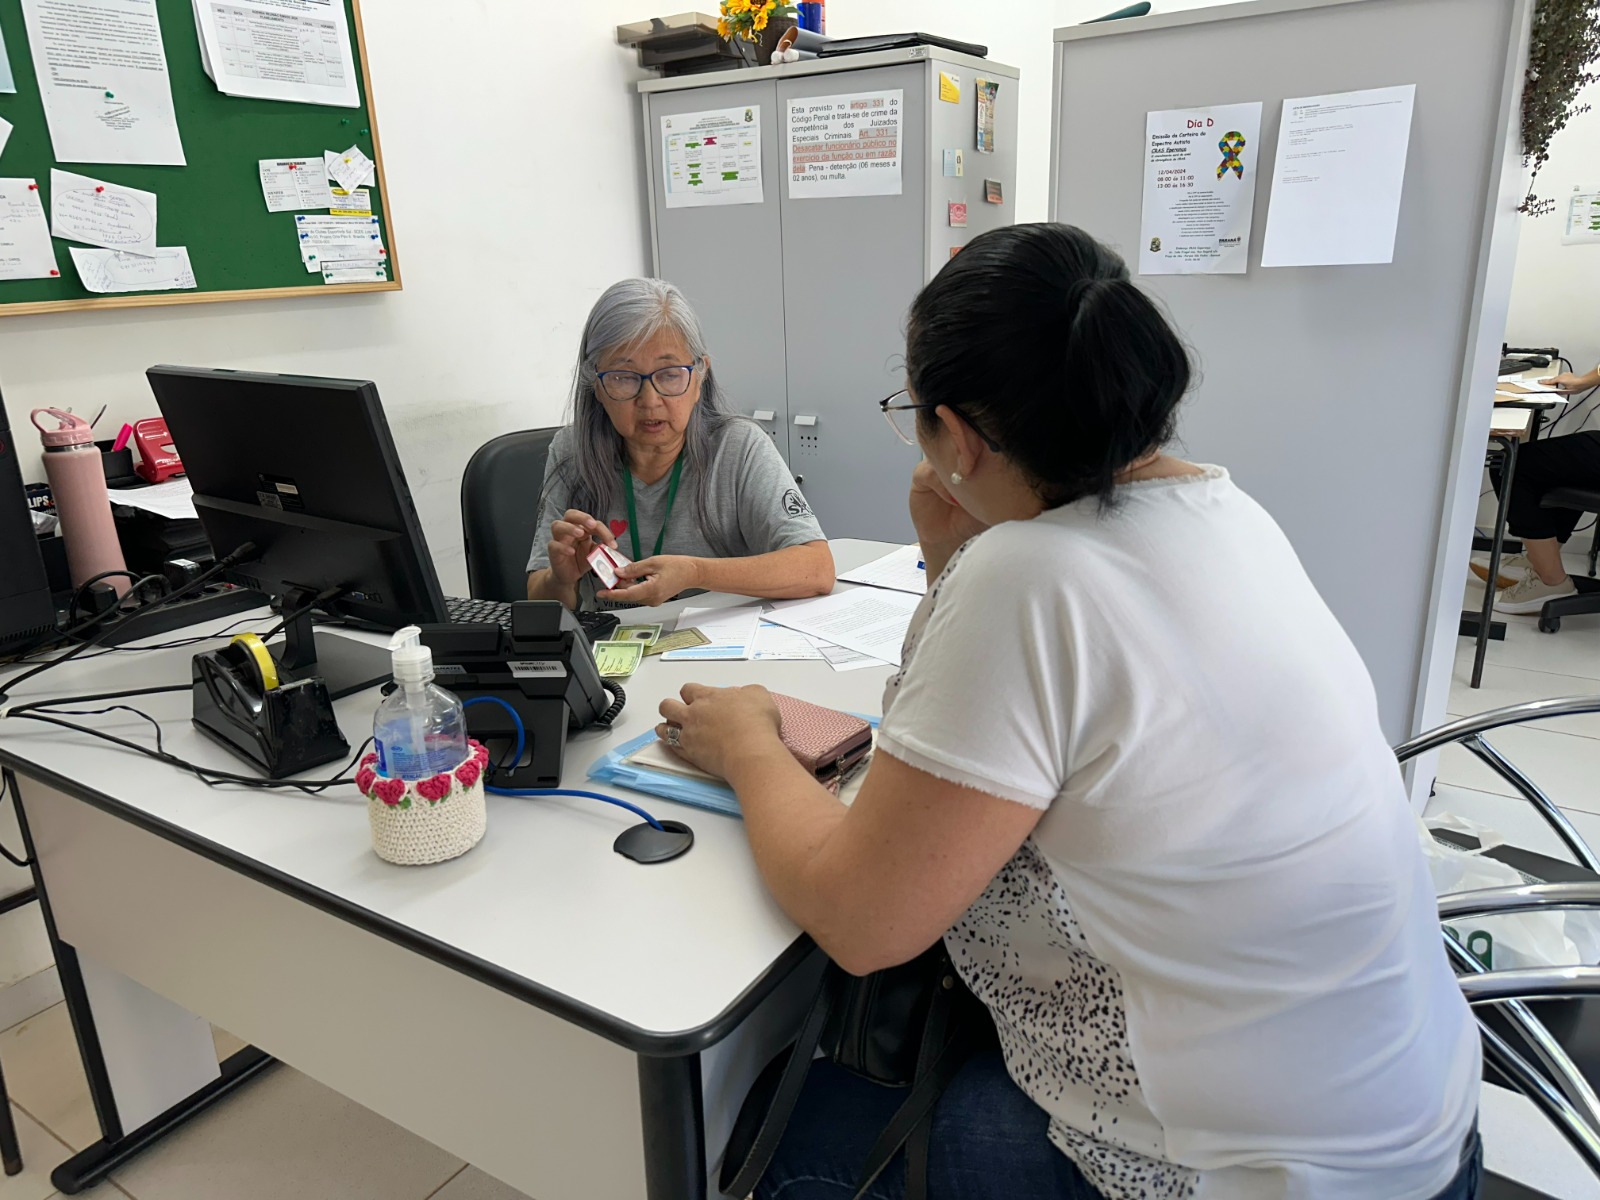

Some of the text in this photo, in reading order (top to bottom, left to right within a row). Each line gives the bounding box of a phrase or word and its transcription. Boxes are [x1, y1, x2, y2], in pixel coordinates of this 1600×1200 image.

[809, 104, 832, 113] previsto
[850, 101, 868, 110] artigo
[872, 99, 884, 107] 331
[792, 115, 812, 124] Código
[814, 113, 830, 121] Penal
[837, 111, 860, 120] trata-se
[861, 110, 869, 118] de
[871, 109, 887, 117] crime
[889, 108, 898, 116] da
[792, 124, 828, 134] competência
[870, 118, 898, 127] Juizados
[1187, 118, 1214, 129] Dia D
[792, 134, 819, 143] Especiais
[824, 132, 851, 141] Criminais
[876, 128, 888, 136] 331
[793, 143, 823, 153] Desacatar
[826, 141, 860, 152] funcionário
[793, 153, 819, 163] exercício
[832, 151, 853, 161] função
[855, 151, 864, 159] ou
[878, 149, 896, 158] razão
[809, 163, 824, 172] Pena
[830, 161, 857, 171] detenção
[859, 161, 868, 170] (06
[27, 495, 49, 508] LIPS
